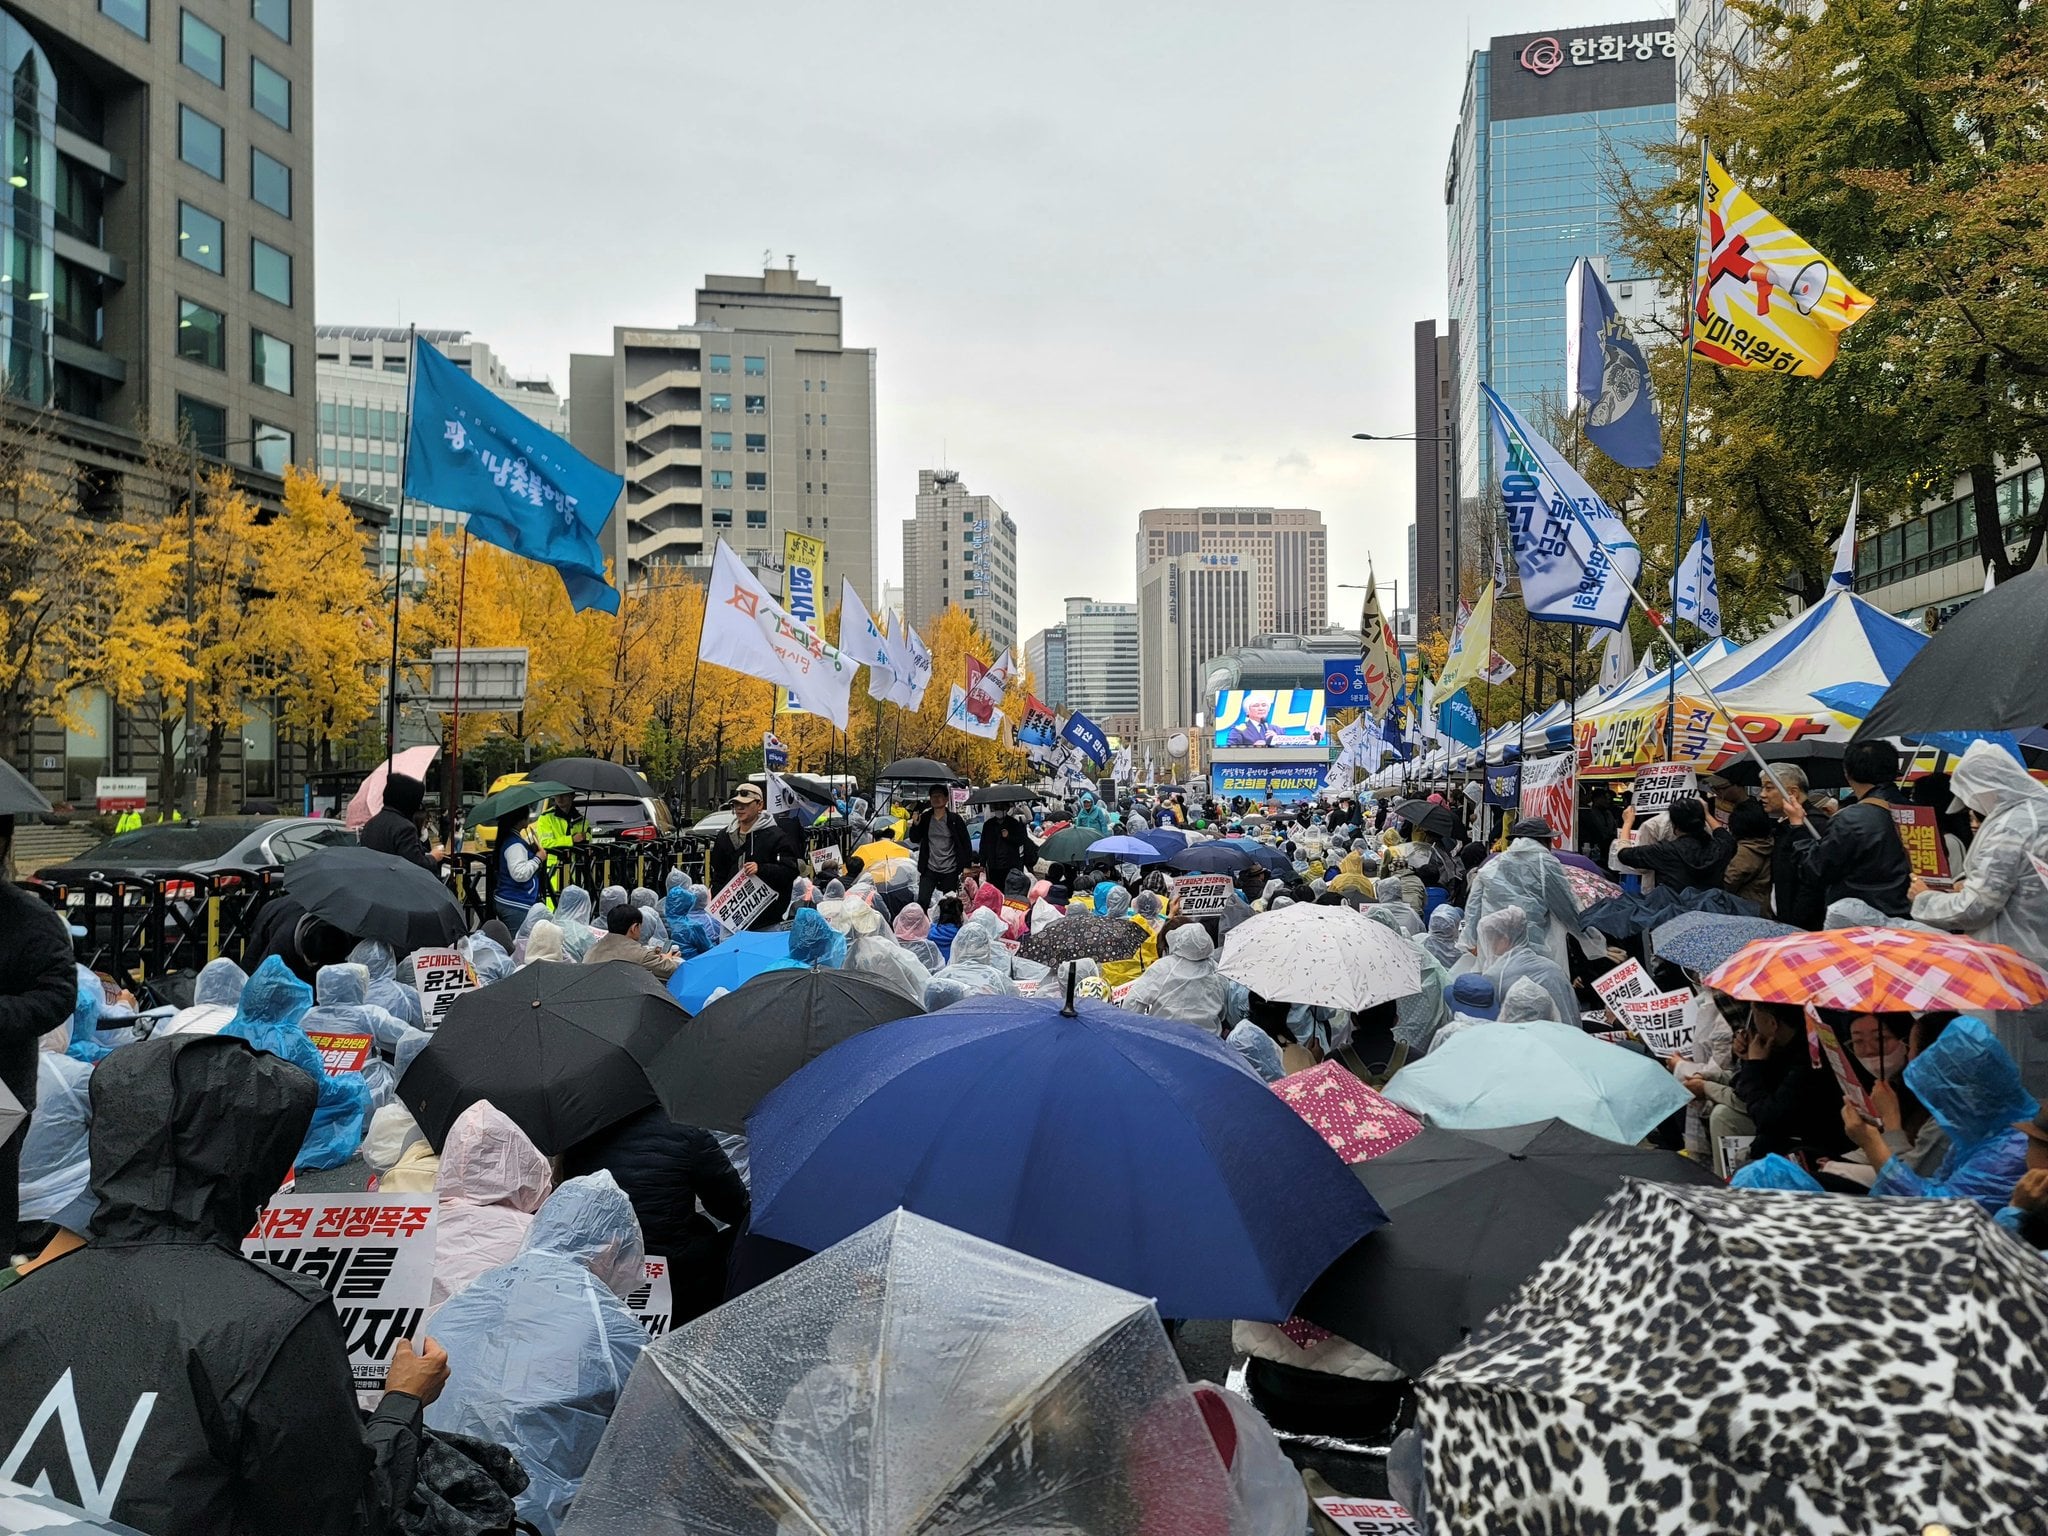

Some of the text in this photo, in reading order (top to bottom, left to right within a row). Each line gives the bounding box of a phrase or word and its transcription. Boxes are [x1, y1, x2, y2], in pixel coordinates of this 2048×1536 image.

[1569, 31, 1677, 66] 한화생명
[1200, 555, 1239, 566] 서울신문
[1072, 723, 1093, 744] 괴산
[1223, 778, 1267, 791] 윤건희를
[1634, 775, 1686, 792] 윤건희를
[718, 879, 756, 922] 윤건희를
[1178, 884, 1226, 898] 윤건희를
[731, 883, 770, 928] 몰아내자!
[331, 1037, 369, 1049] 공안탄압
[312, 1206, 433, 1239] 전쟁폭주
